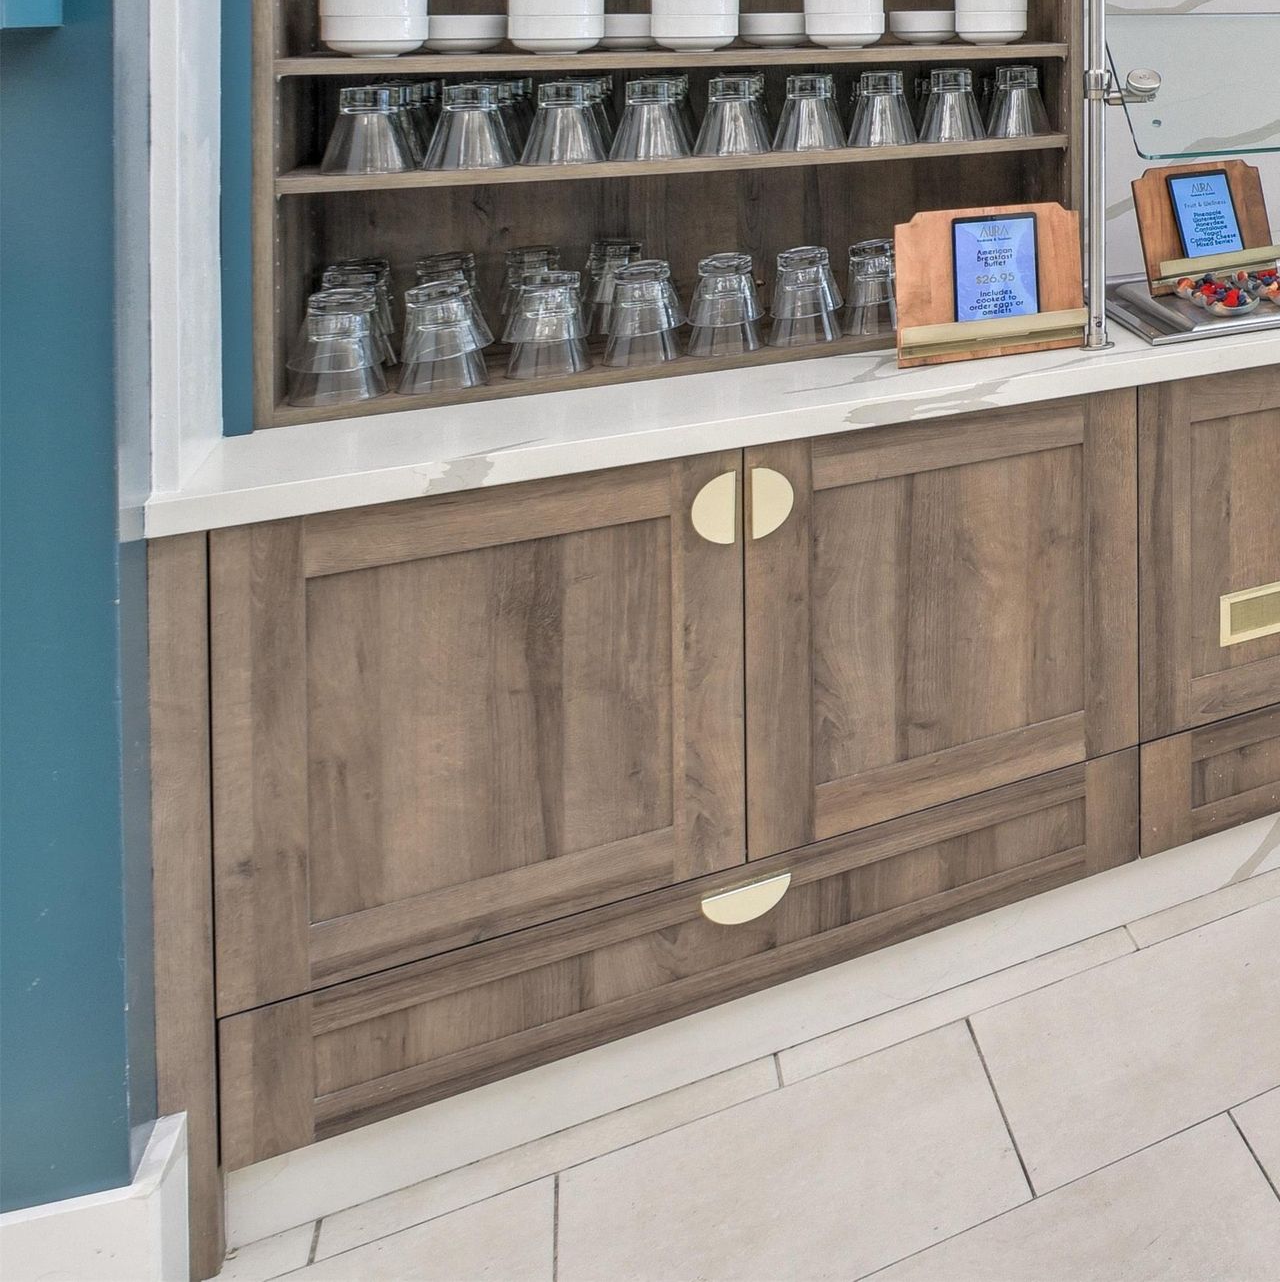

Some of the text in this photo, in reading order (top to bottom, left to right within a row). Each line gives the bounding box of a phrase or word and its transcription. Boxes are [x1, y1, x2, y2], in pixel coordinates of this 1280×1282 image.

[1191, 182, 1213, 193] AURA
[1193, 210, 1222, 218] Pineapple
[1193, 215, 1225, 223] Watermelon
[980, 224, 1009, 238] AURA
[1194, 225, 1227, 233] Cantaloupe
[1190, 236, 1214, 244] Cottage
[977, 248, 1012, 256] American
[977, 254, 1012, 262] Breakfast
[976, 272, 1015, 285] $26.95
[980, 289, 1012, 297] Includes
[976, 296, 1006, 304] cooked
